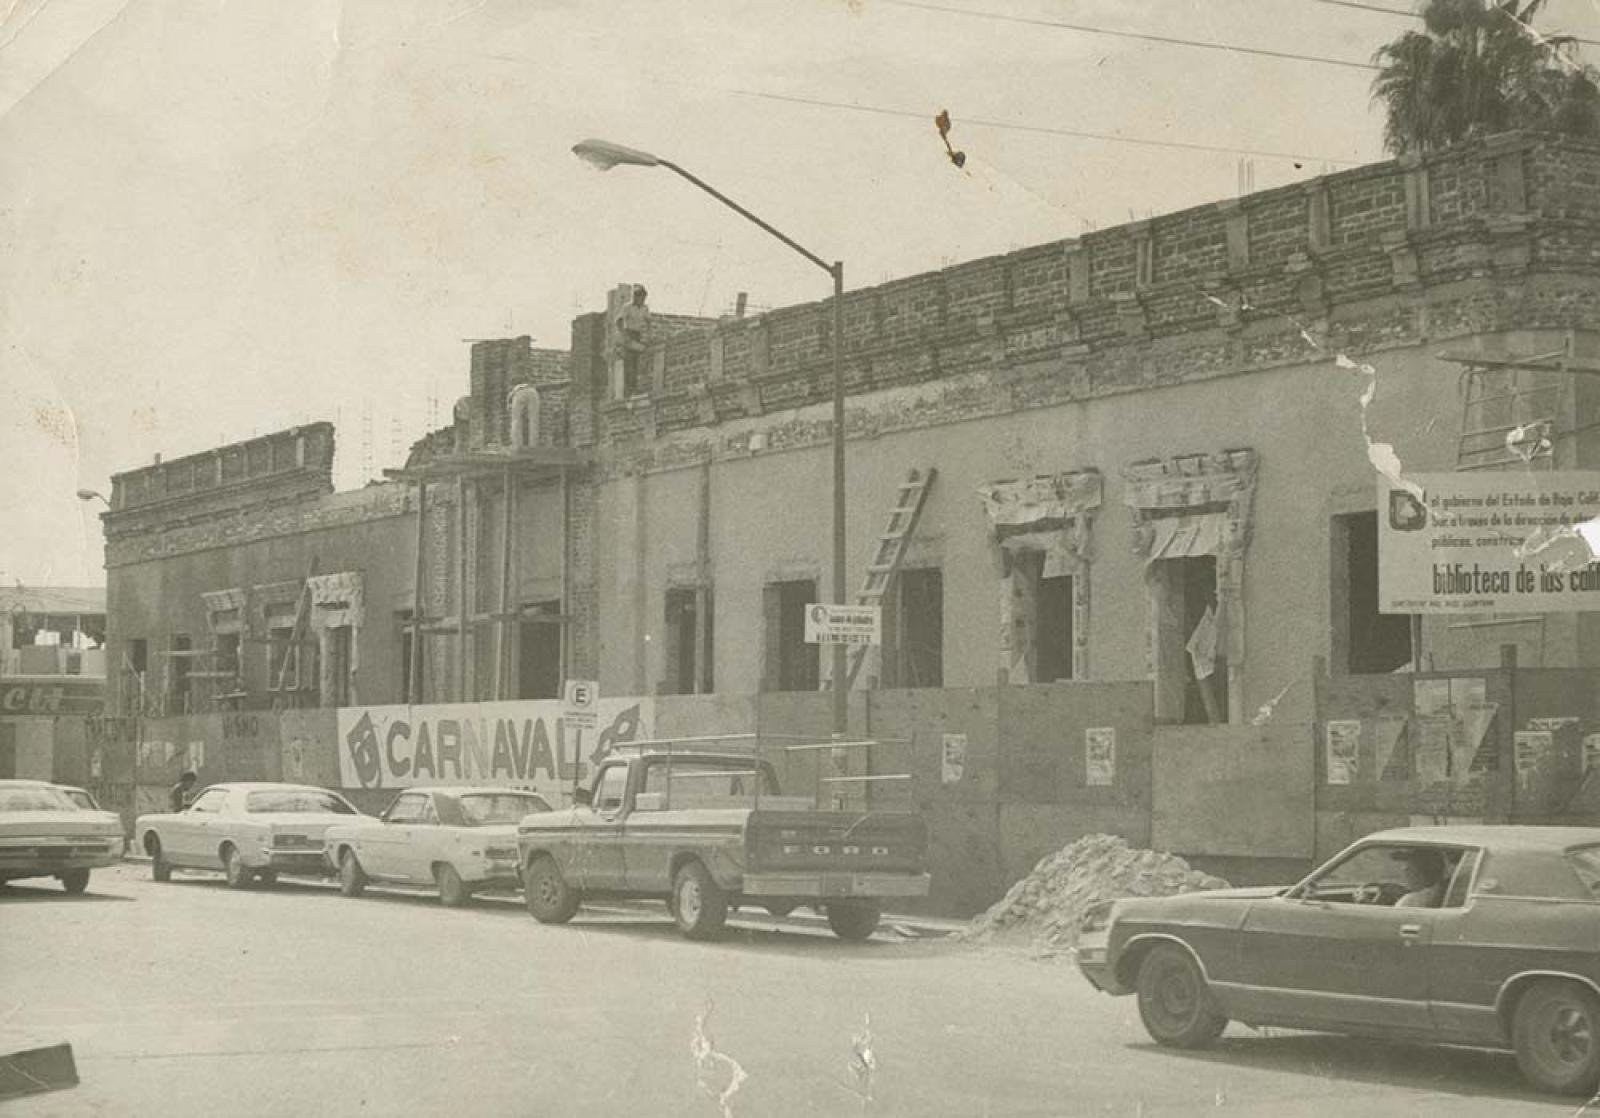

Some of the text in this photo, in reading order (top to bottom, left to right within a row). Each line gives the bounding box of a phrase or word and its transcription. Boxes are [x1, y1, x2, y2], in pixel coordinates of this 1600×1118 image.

[1441, 494, 1483, 510] gobierno
[1485, 494, 1499, 506] del
[1502, 493, 1536, 507] Estado
[1538, 493, 1550, 506] de
[1552, 491, 1574, 508] Baja
[1490, 512, 1501, 527] de
[1503, 512, 1513, 526] la
[1433, 562, 1510, 594] biblioteca
[1515, 562, 1535, 594] de
[1540, 562, 1563, 593] las
[575, 687, 587, 704] E
[386, 717, 588, 781] CARNAVAL
[783, 844, 889, 855] FORD
